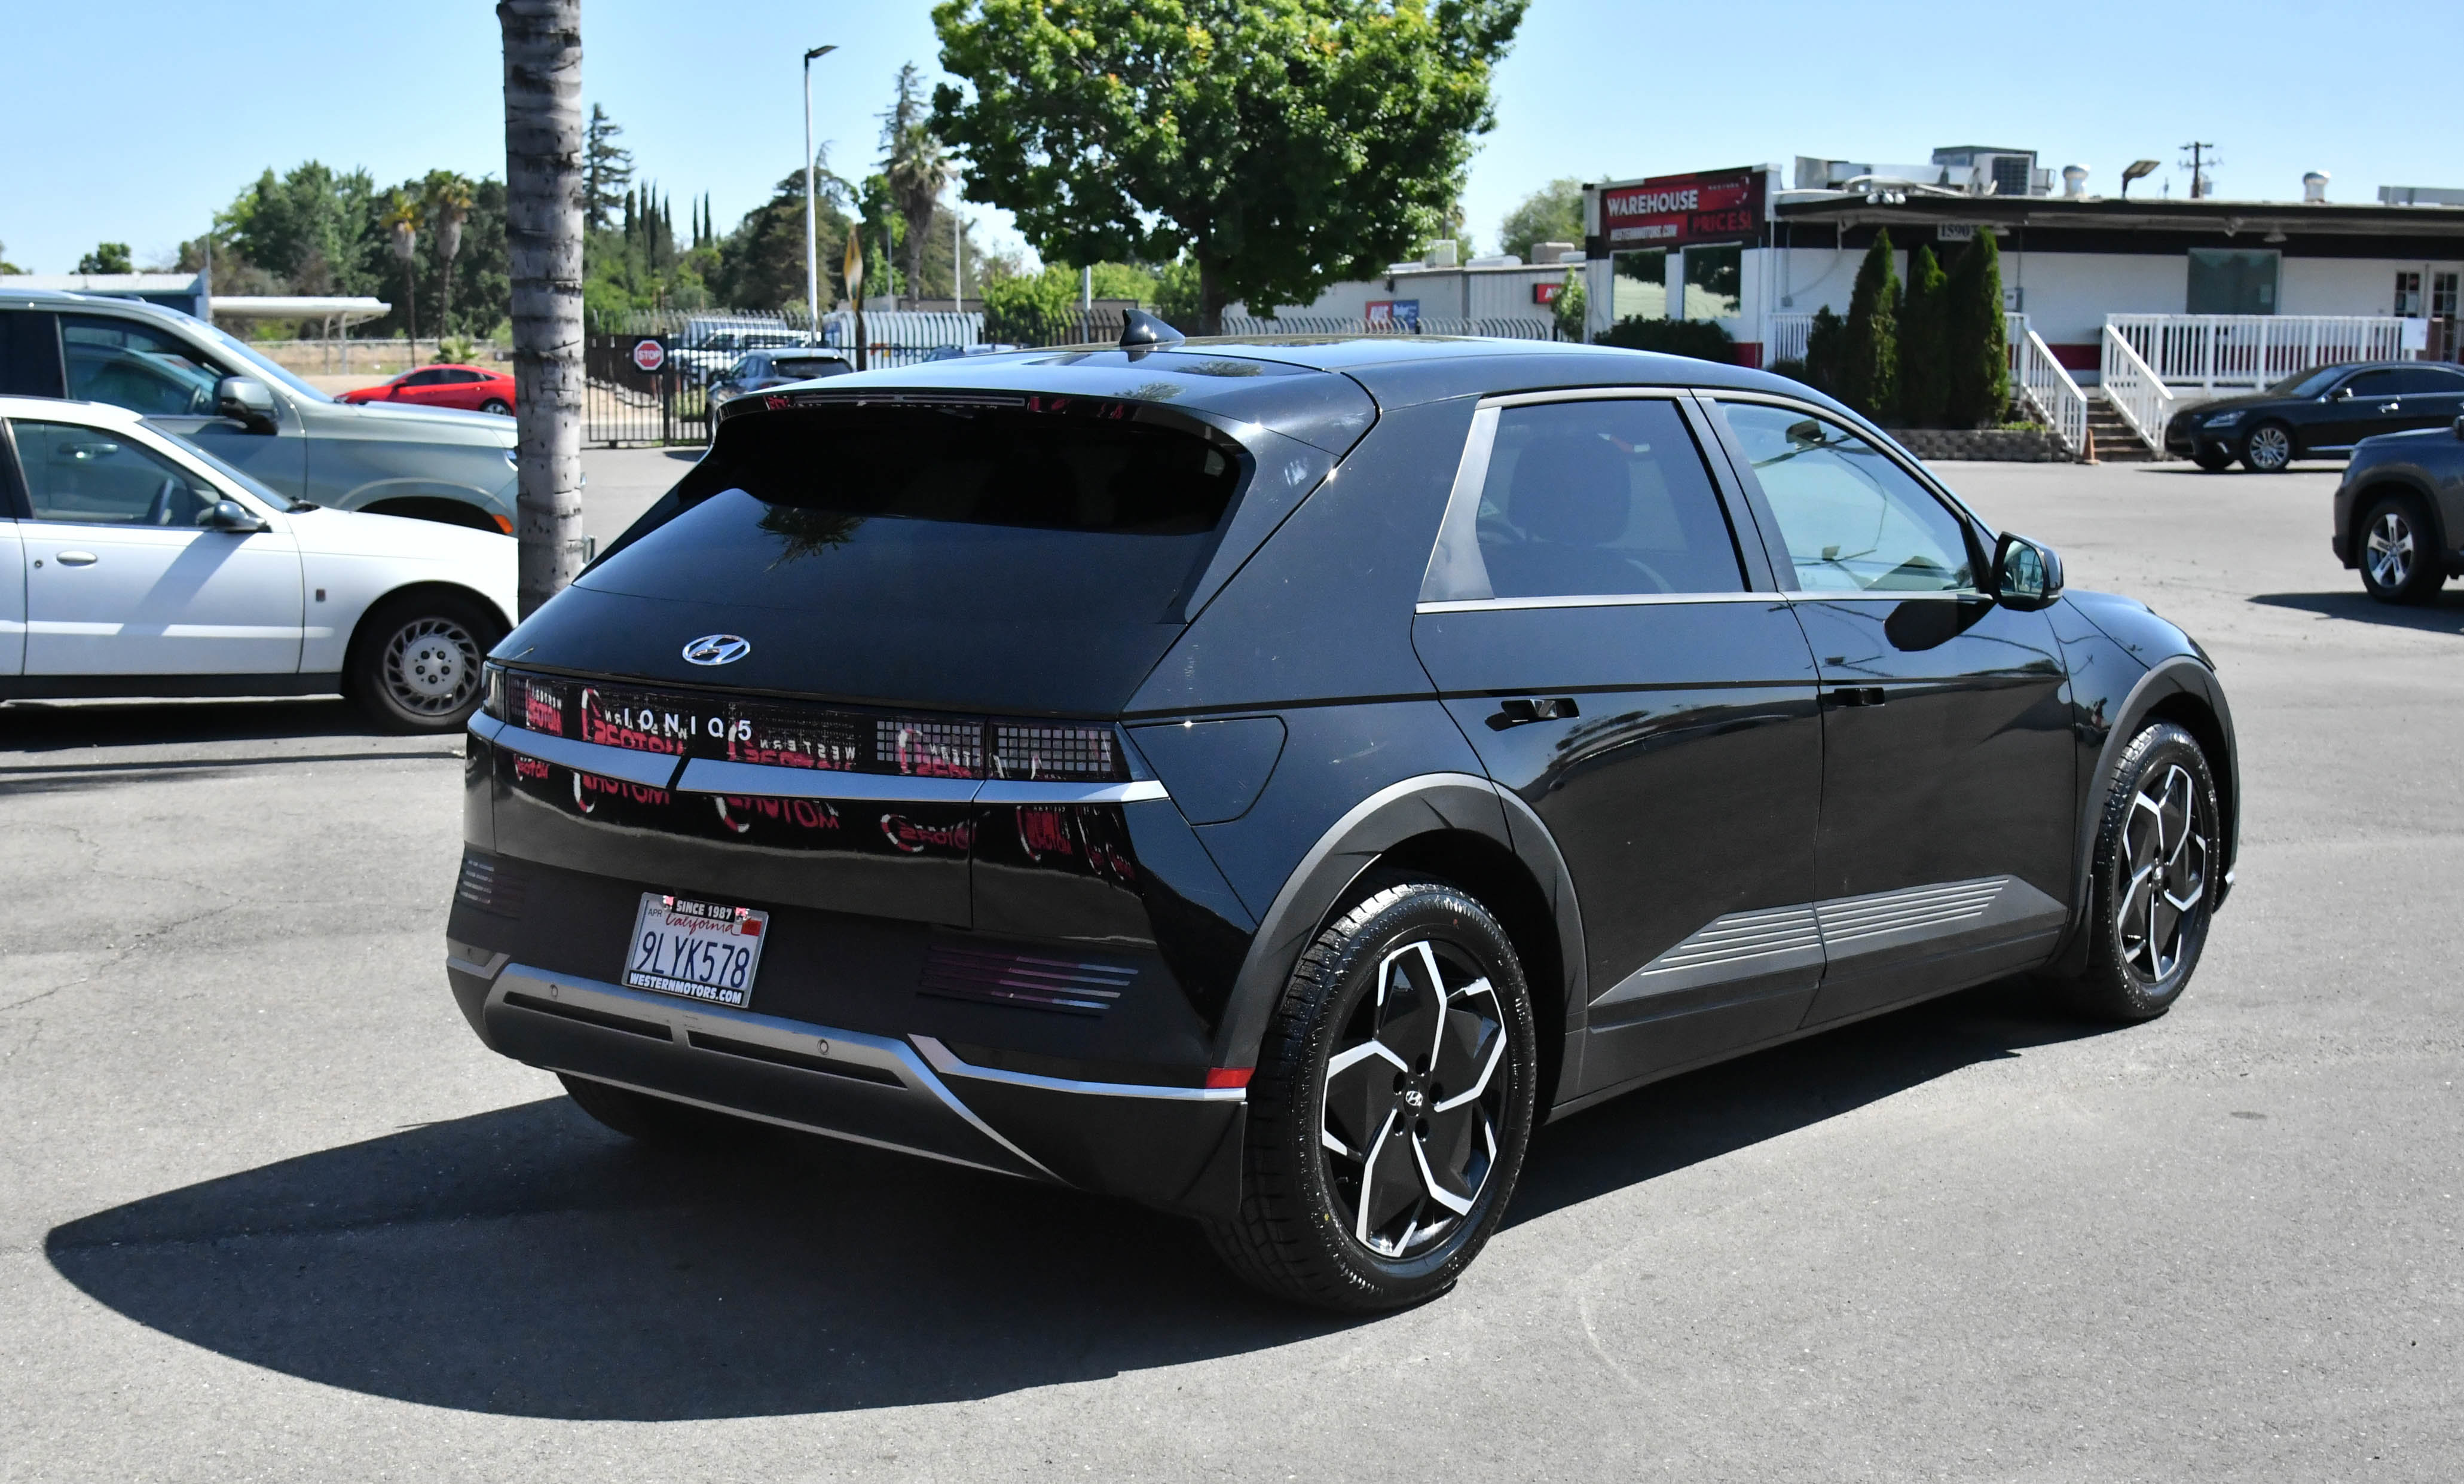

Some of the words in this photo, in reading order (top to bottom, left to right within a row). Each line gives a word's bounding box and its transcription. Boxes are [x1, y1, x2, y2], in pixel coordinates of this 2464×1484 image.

[1607, 189, 1698, 217] WAREHOUSE
[623, 708, 724, 738] IONIQ
[737, 720, 752, 741] 5
[647, 908, 662, 918] APR
[676, 900, 705, 916] SINCE
[707, 904, 732, 920] 1987
[665, 913, 740, 936] California
[636, 931, 750, 989] 9LYK578
[629, 972, 742, 1005] WESTERNMOTORS.COM
